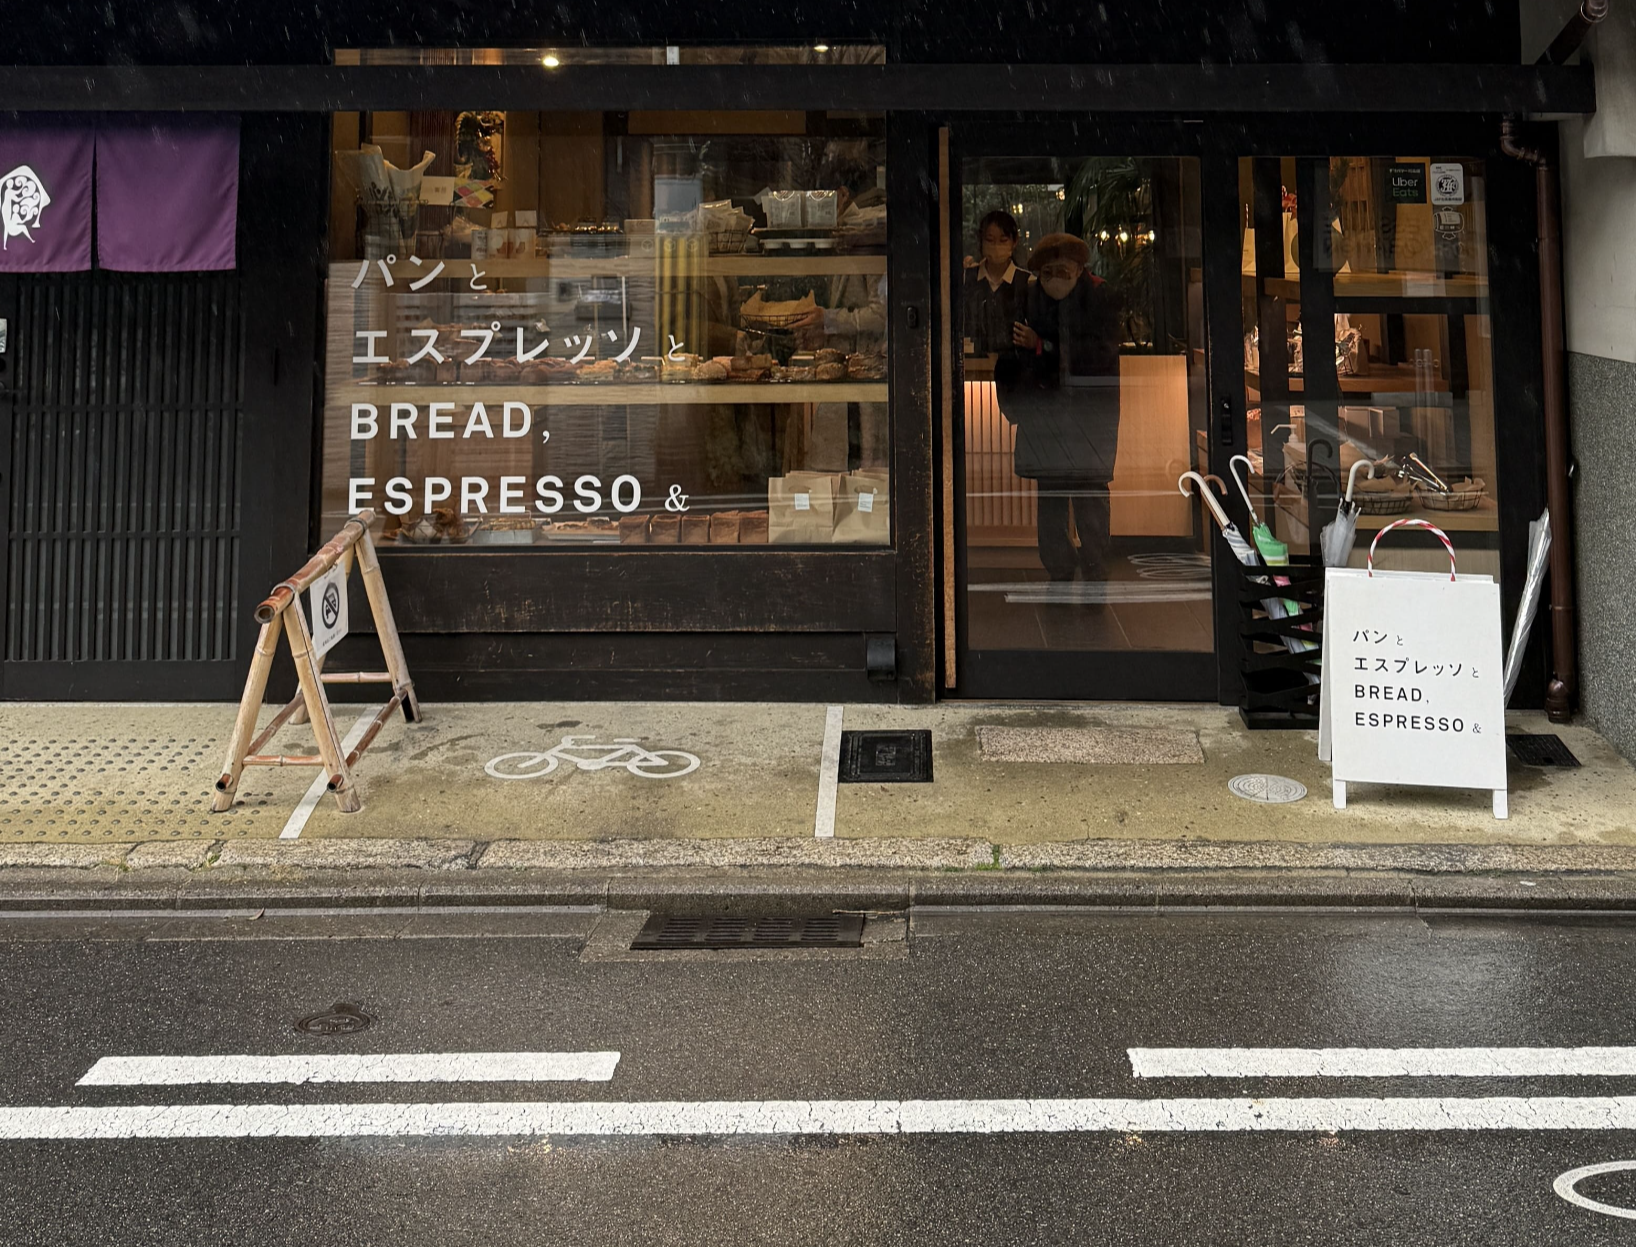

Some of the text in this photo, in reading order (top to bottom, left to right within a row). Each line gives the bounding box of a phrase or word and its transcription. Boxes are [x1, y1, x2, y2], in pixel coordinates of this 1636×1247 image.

[1392, 177, 1419, 187] Uber
[1392, 187, 1419, 198] Eats
[350, 401, 551, 444] BREAD,
[348, 474, 690, 515] ESPRESSO &
[1354, 684, 1430, 704] BREAD,
[1355, 711, 1483, 734] ESPRESSO &
